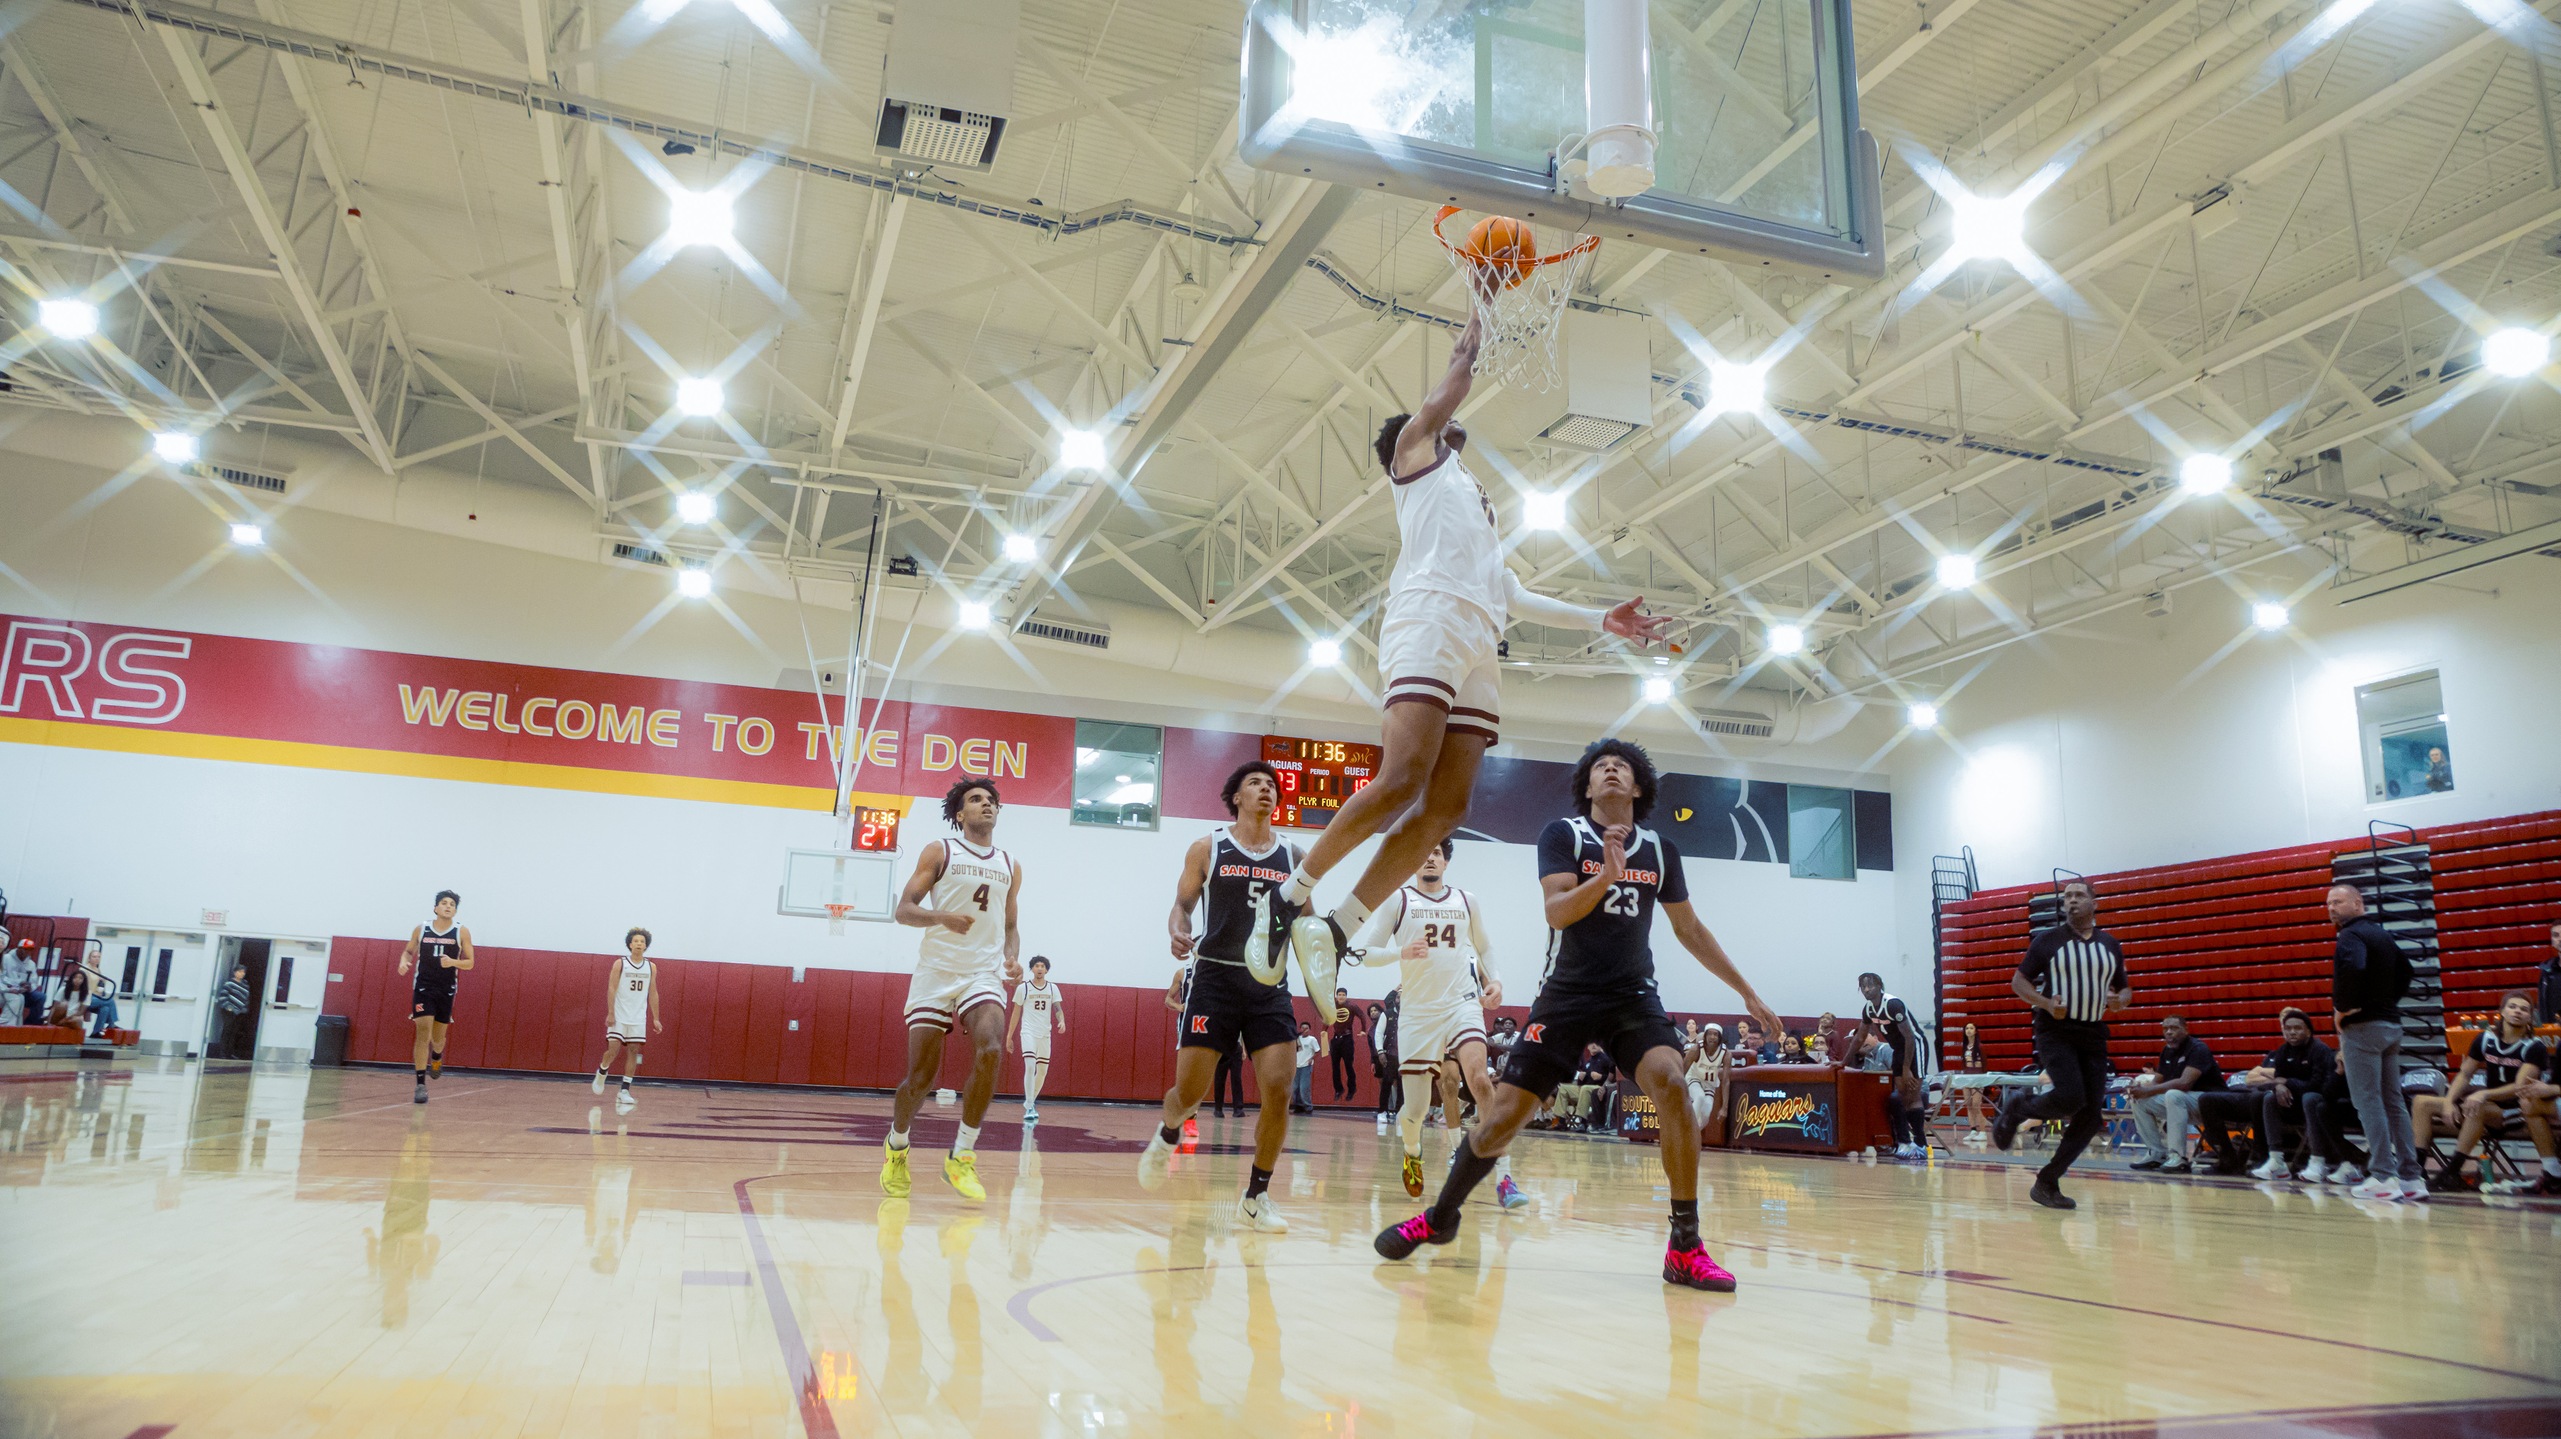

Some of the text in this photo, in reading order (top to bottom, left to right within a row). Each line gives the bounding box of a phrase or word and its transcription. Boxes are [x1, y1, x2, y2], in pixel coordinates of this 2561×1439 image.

[0, 621, 192, 725] RS
[398, 683, 1028, 779] WELCOME TO THE DEN
[1301, 742, 1346, 762] 11:36
[1310, 768, 1330, 776] PERIOD
[1344, 766, 1370, 776] GUEST
[1320, 778, 1324, 790] 1
[1298, 796, 1340, 808] PLYR FOUL
[861, 811, 896, 825] 11:36
[1287, 811, 1295, 821] 6
[861, 824, 889, 847] 27
[951, 863, 1010, 886] SOUTHWESTERN
[1219, 864, 1291, 882] SAN DIEGO
[972, 884, 991, 912] 4
[1247, 881, 1264, 909] 5
[1604, 884, 1640, 917] 23
[1410, 908, 1466, 921] SOUTHWESTERN
[1425, 923, 1456, 949] 24
[433, 945, 445, 957] 11
[630, 980, 644, 992] 30
[1034, 1000, 1046, 1010] 23
[1191, 1015, 1209, 1033] K
[1524, 1023, 1546, 1043] K
[1704, 1071, 1714, 1082] 11
[1759, 1090, 1786, 1098] Home of the
[1734, 1092, 1815, 1139] Jaguars
